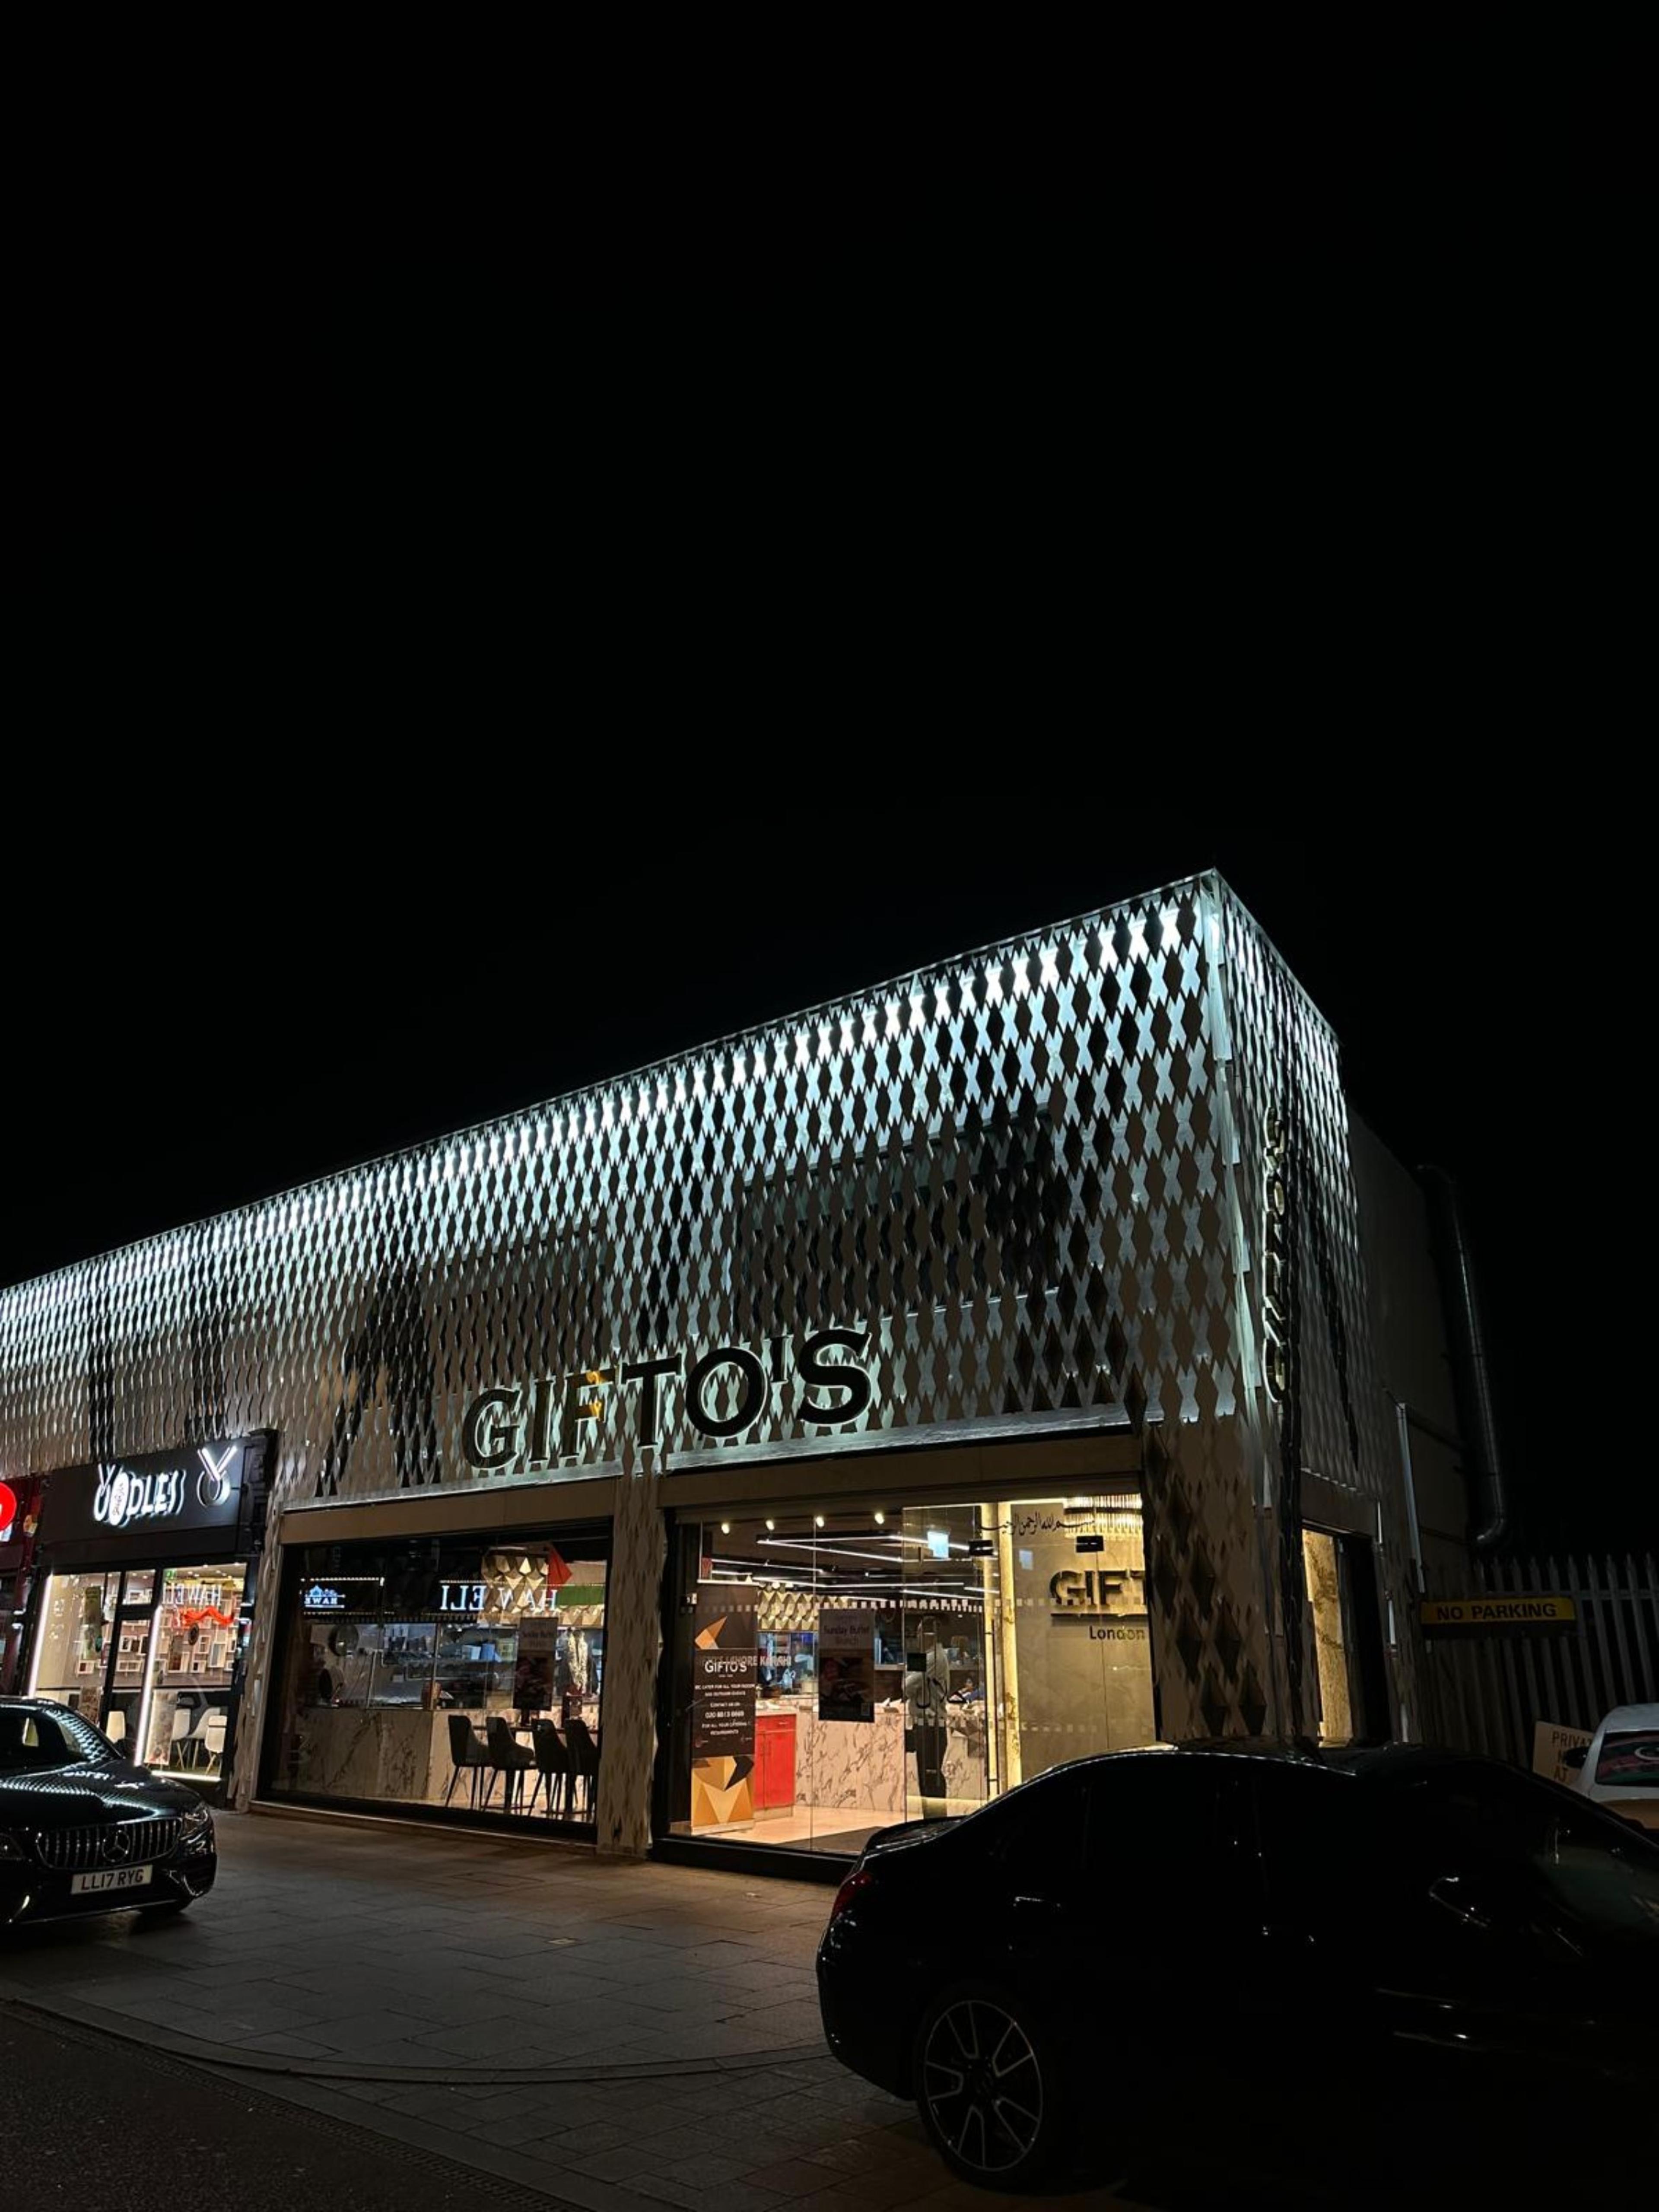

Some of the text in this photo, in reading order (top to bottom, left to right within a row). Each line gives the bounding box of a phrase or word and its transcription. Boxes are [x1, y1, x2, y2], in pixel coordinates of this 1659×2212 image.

[461, 1328, 872, 1470] GIFTO'S
[1437, 1603, 1557, 1620] NO PARKING
[1089, 1625, 1145, 1640] London
[81, 1869, 144, 1890] LL17 RYG
